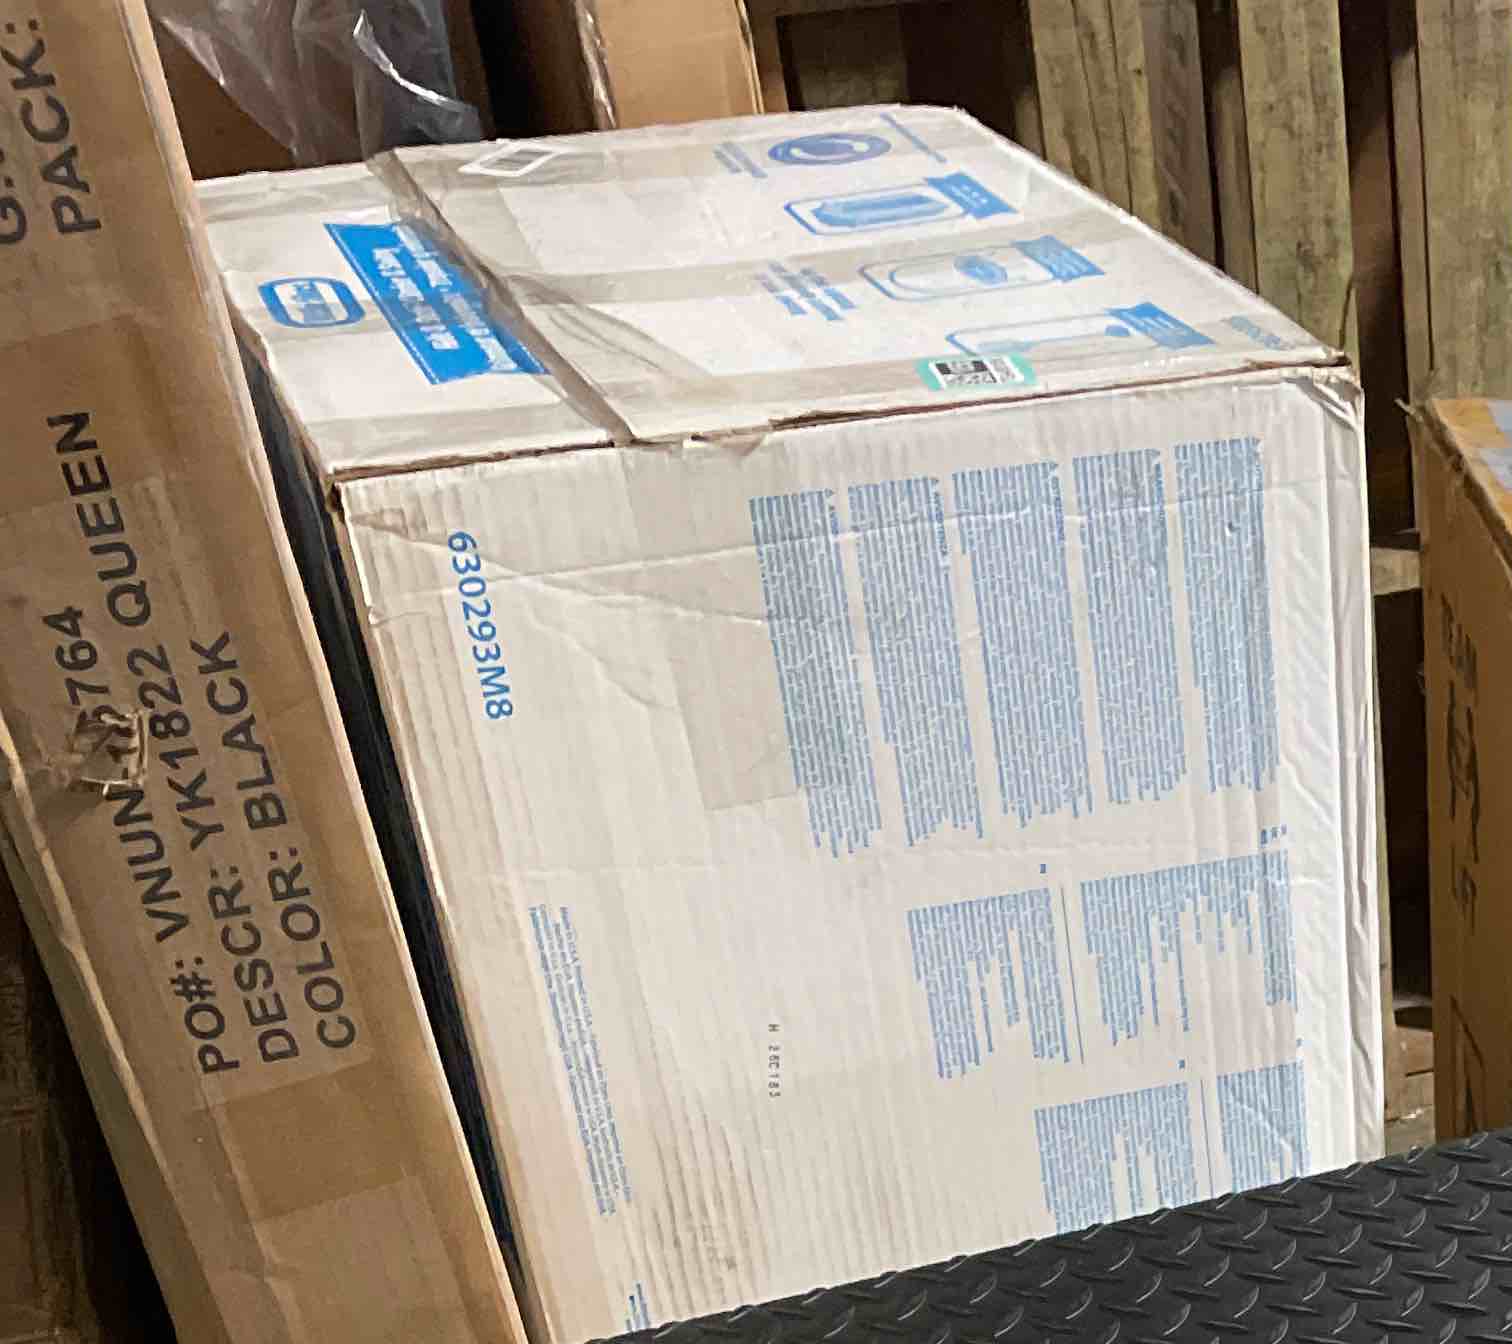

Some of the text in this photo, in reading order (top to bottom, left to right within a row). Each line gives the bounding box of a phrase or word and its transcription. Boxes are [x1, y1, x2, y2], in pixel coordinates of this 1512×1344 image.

[0, 19, 101, 234] PACK:
[447, 531, 513, 720] 630293M8
[47, 413, 298, 1062] DESCR: YK1822 QUEEN
[190, 631, 357, 1048] COLOR: BLACK
[171, 958, 240, 1073] PO#:
